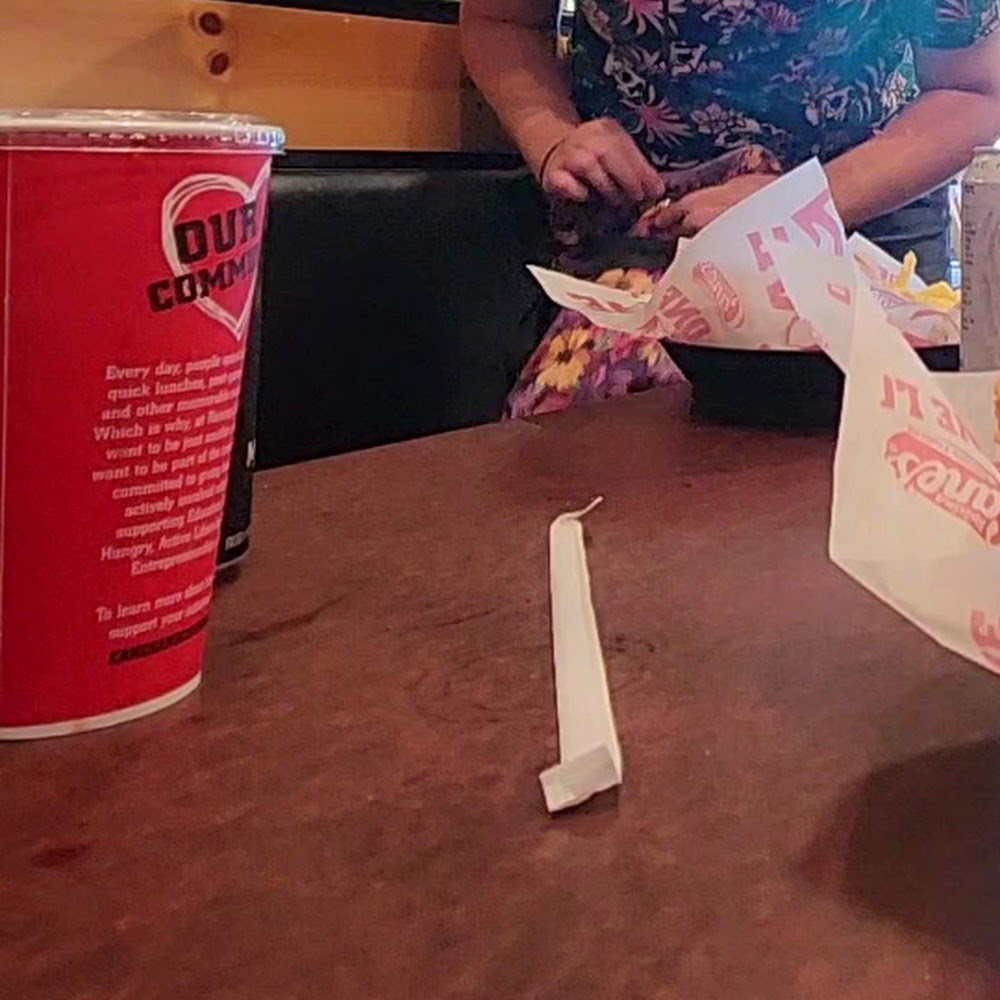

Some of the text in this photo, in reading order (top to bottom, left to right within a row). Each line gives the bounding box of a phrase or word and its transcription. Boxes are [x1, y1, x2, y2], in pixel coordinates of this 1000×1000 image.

[174, 200, 256, 264] OUR
[105, 364, 151, 380] Every
[154, 361, 182, 377] day,
[107, 383, 151, 401] quick
[101, 404, 132, 421] and
[136, 401, 175, 417] other
[93, 422, 144, 442] Which
[147, 423, 162, 436] is
[105, 443, 143, 460] want
[147, 442, 162, 455] to
[164, 438, 181, 453] be
[92, 465, 131, 482] want
[134, 463, 149, 477] to
[151, 460, 169, 475] be
[96, 605, 113, 623] To
[116, 601, 152, 620] learn
